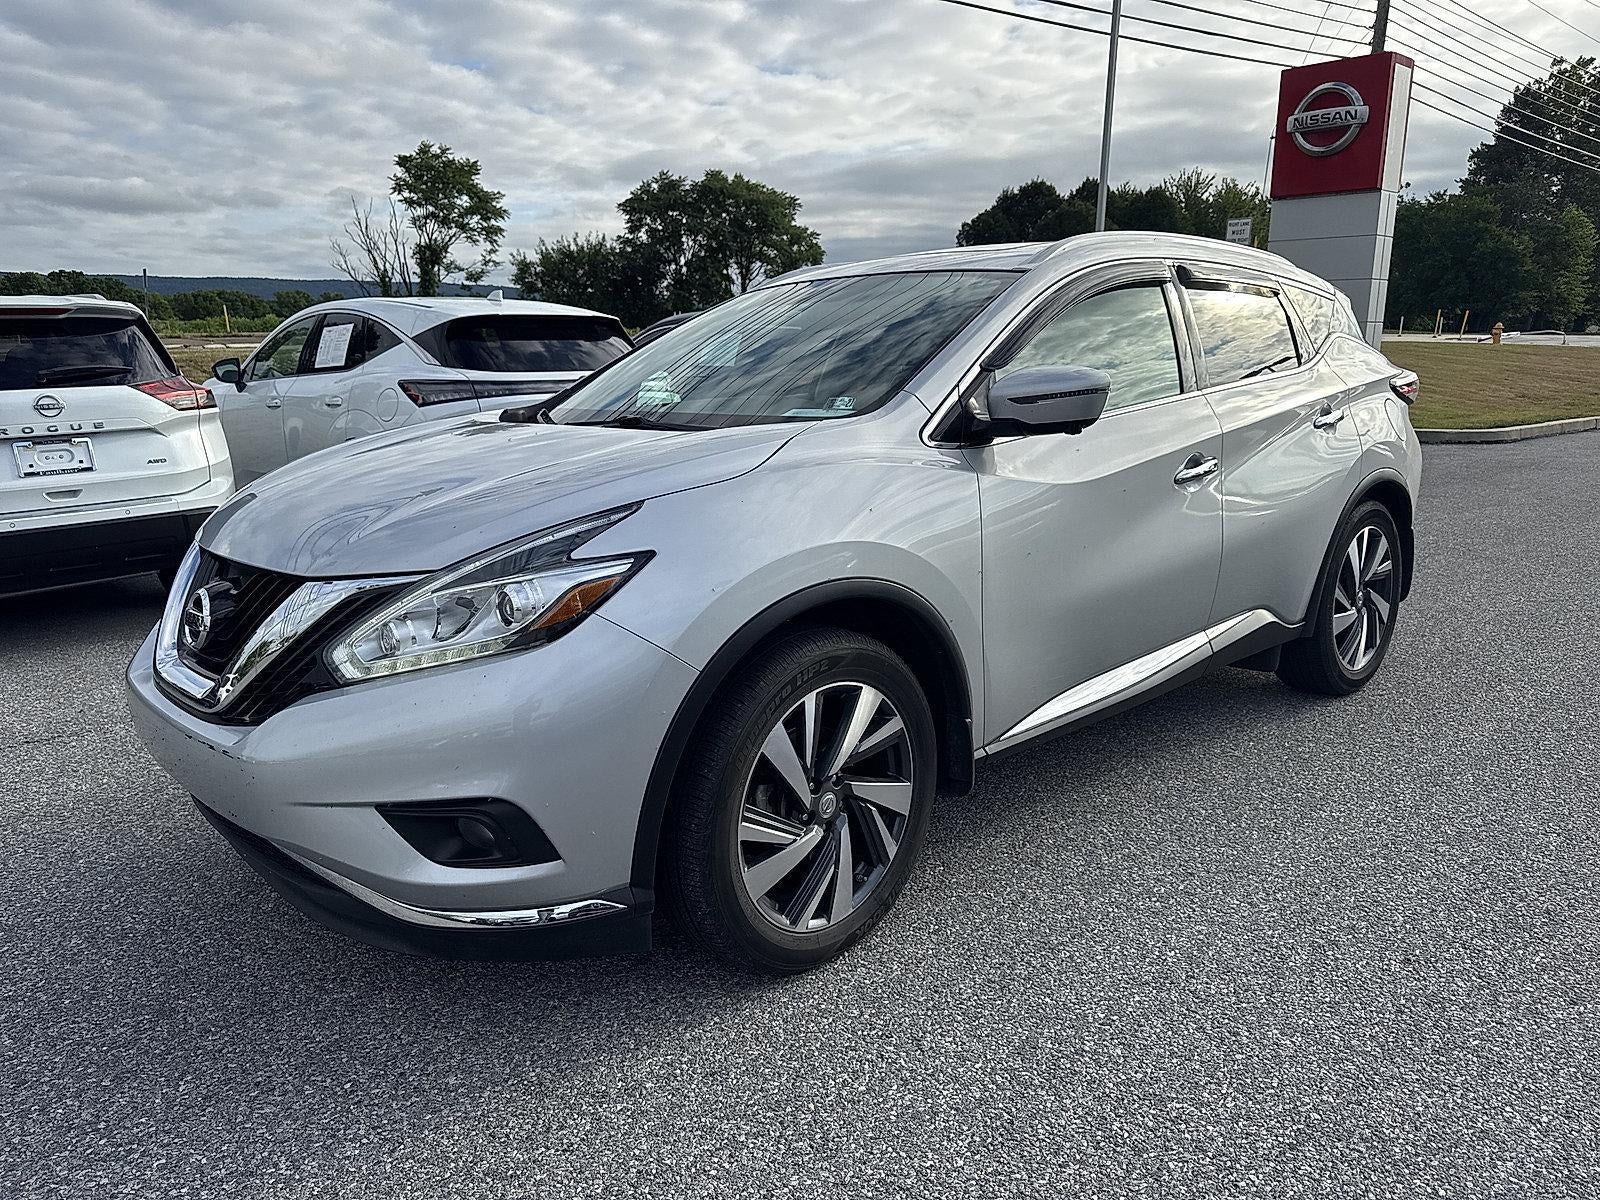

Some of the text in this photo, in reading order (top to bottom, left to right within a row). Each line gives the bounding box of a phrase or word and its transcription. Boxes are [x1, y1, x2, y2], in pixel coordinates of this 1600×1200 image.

[1292, 109, 1358, 128] NISSAN
[0, 421, 105, 436] ROGUE
[39, 467, 80, 476] Faulkner
